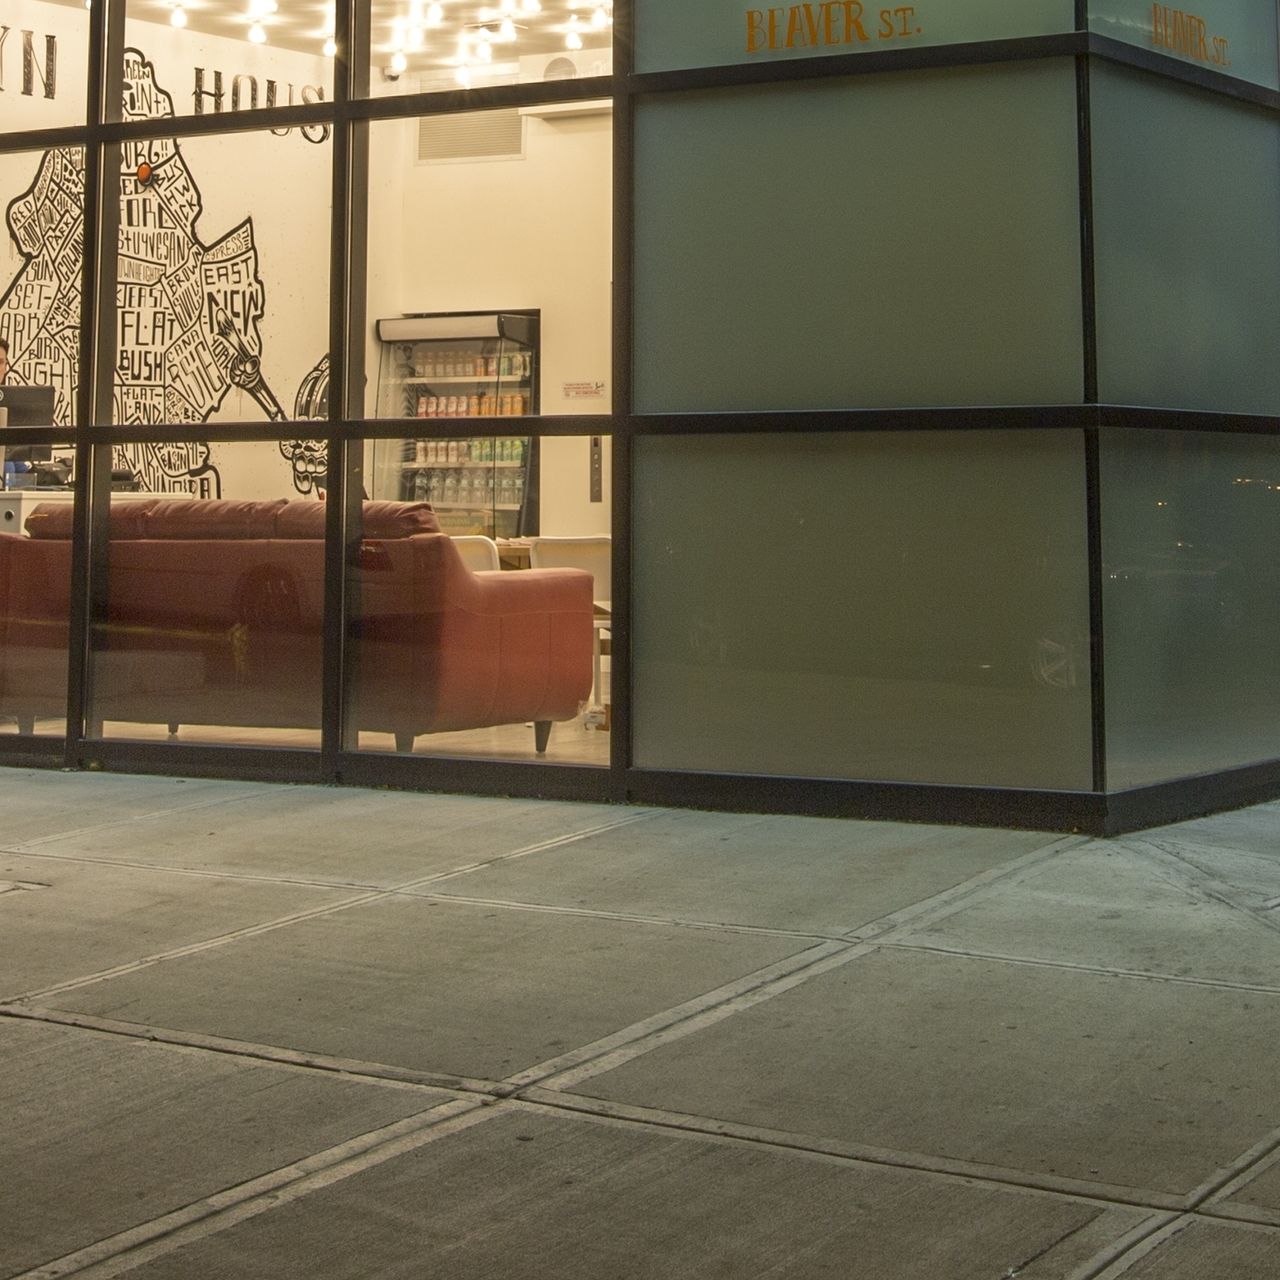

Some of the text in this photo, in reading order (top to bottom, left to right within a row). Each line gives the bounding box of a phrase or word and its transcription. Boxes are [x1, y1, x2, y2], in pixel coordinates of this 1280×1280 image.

[746, 0, 922, 53] BEAVER ST.
[192, 67, 330, 144] HOUS
[204, 256, 252, 286] EAST
[118, 349, 163, 382] BUSH
